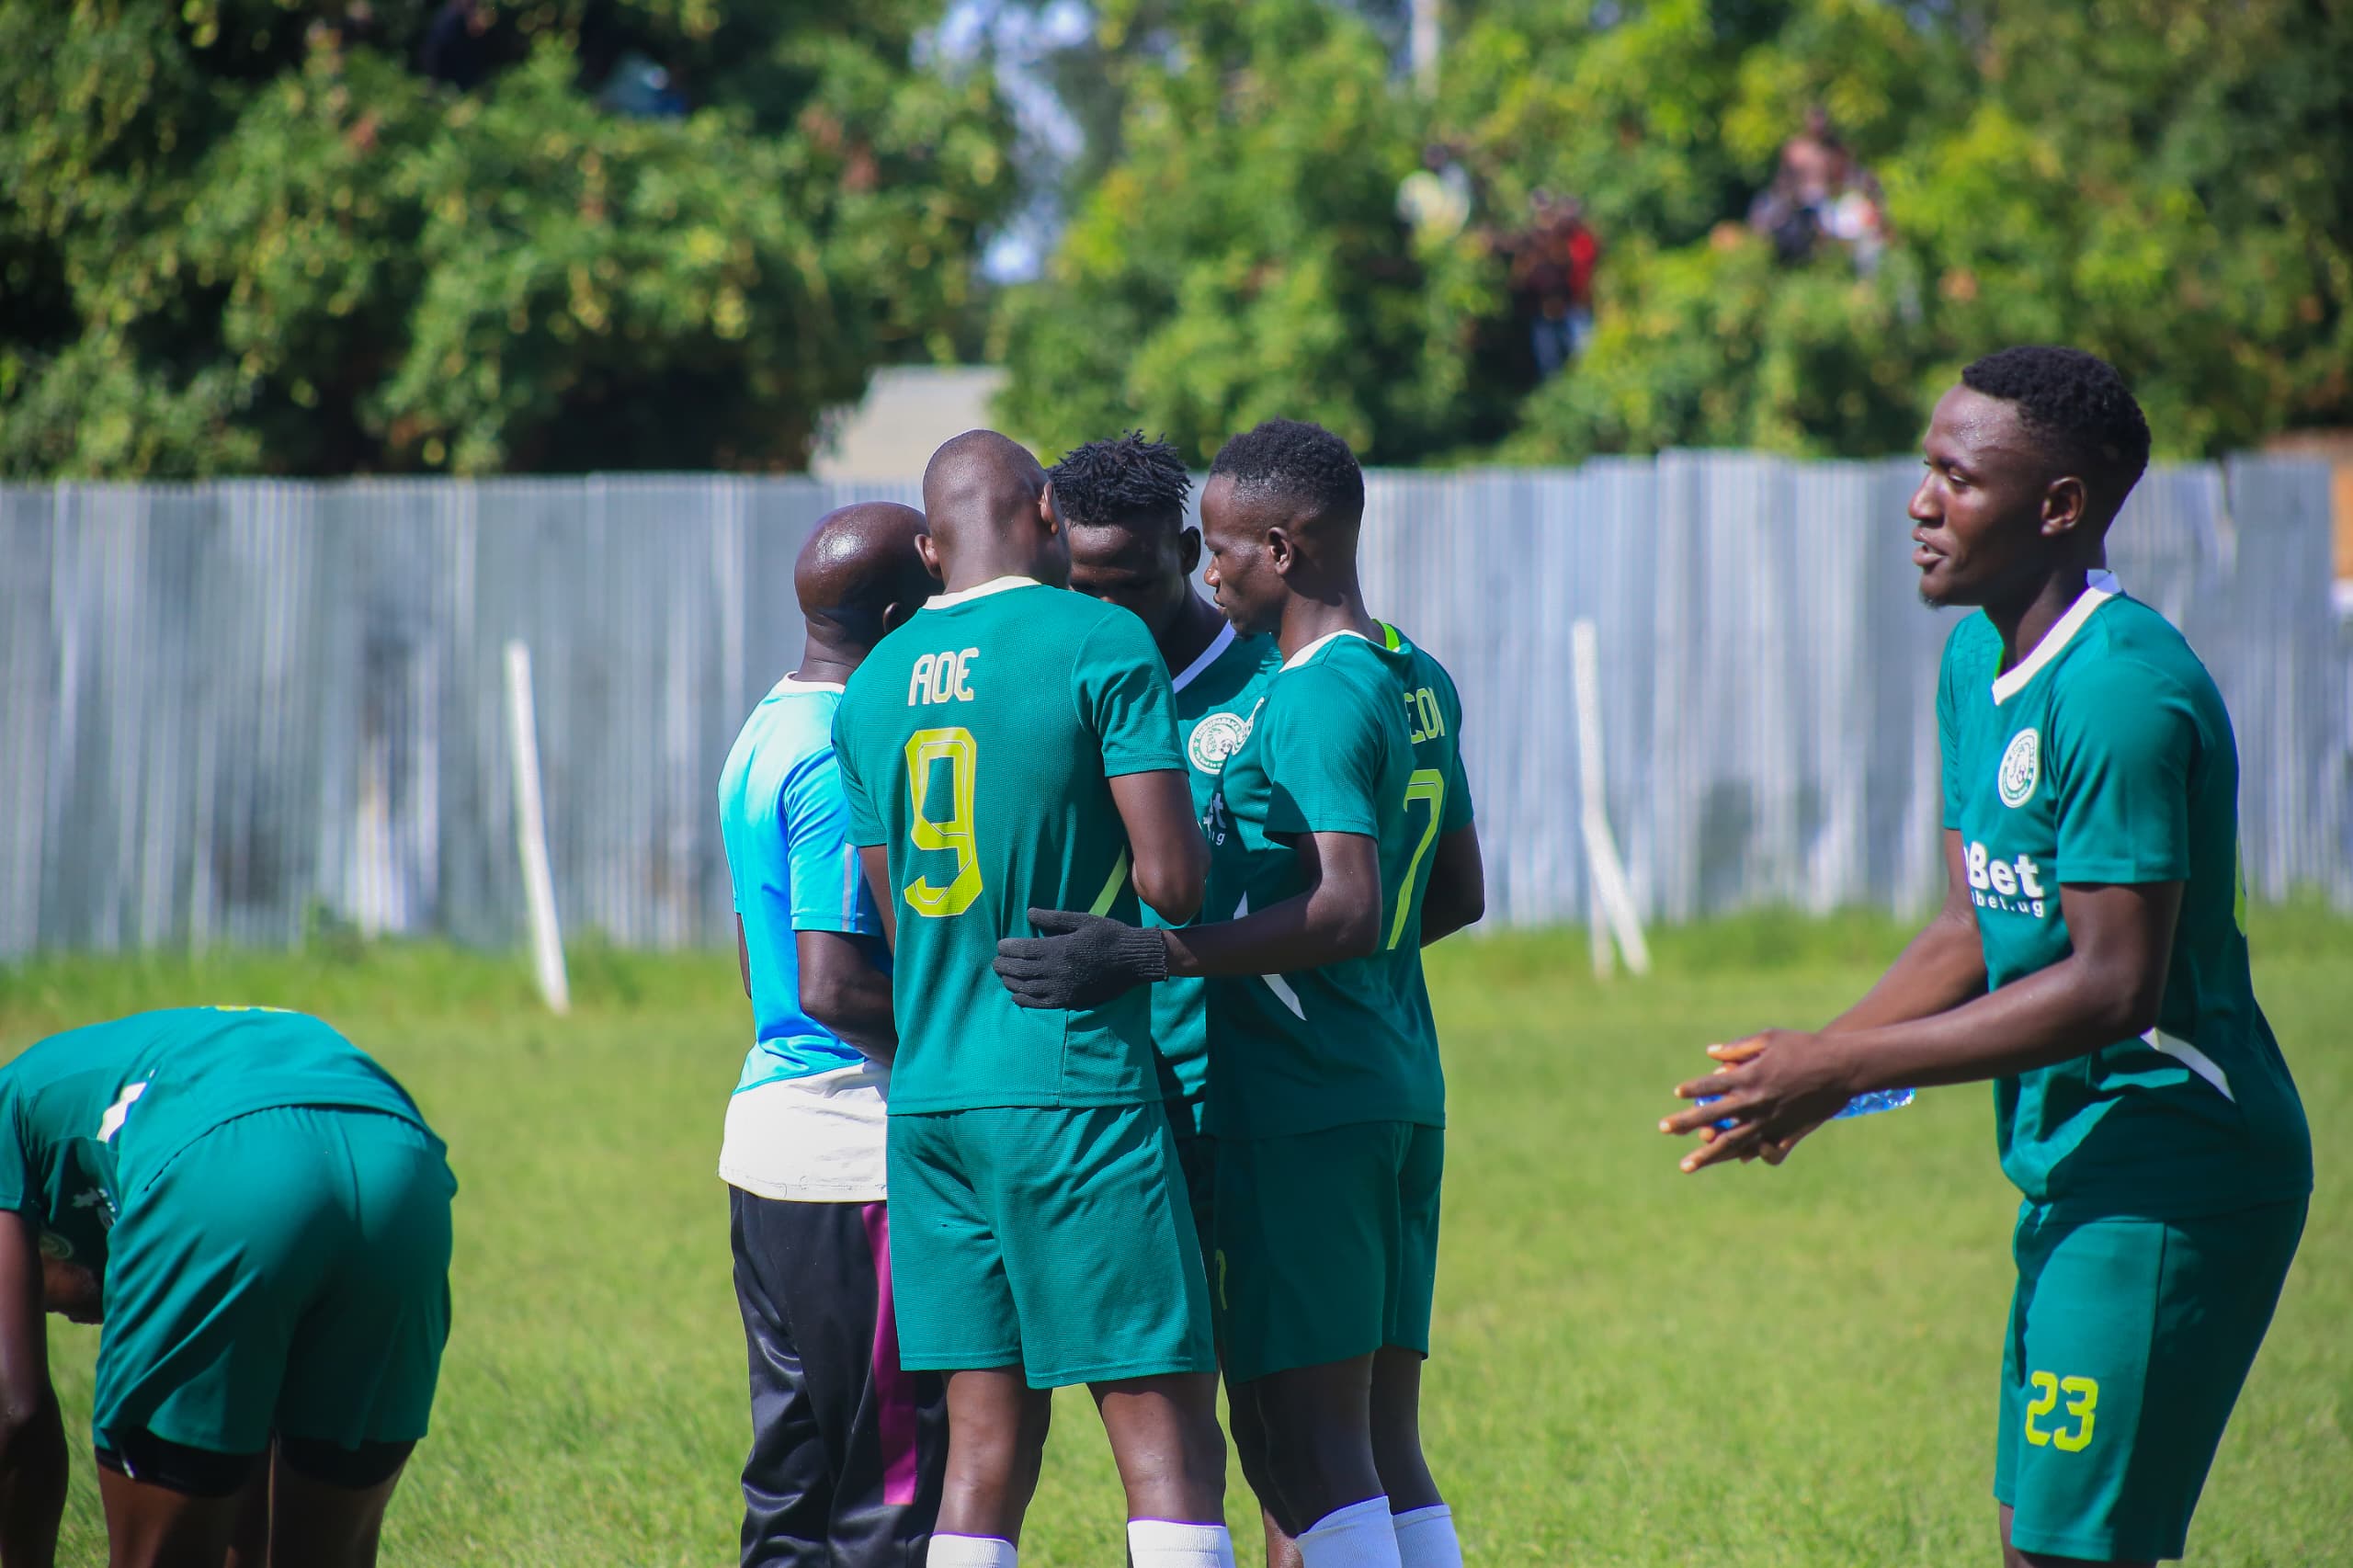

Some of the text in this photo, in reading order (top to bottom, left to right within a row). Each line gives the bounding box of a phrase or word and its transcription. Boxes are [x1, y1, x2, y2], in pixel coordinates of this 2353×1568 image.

[904, 727, 983, 917] 9
[1386, 768, 1445, 950] 7
[1963, 841, 2045, 899] Bet
[2025, 1369, 2099, 1453] 23
